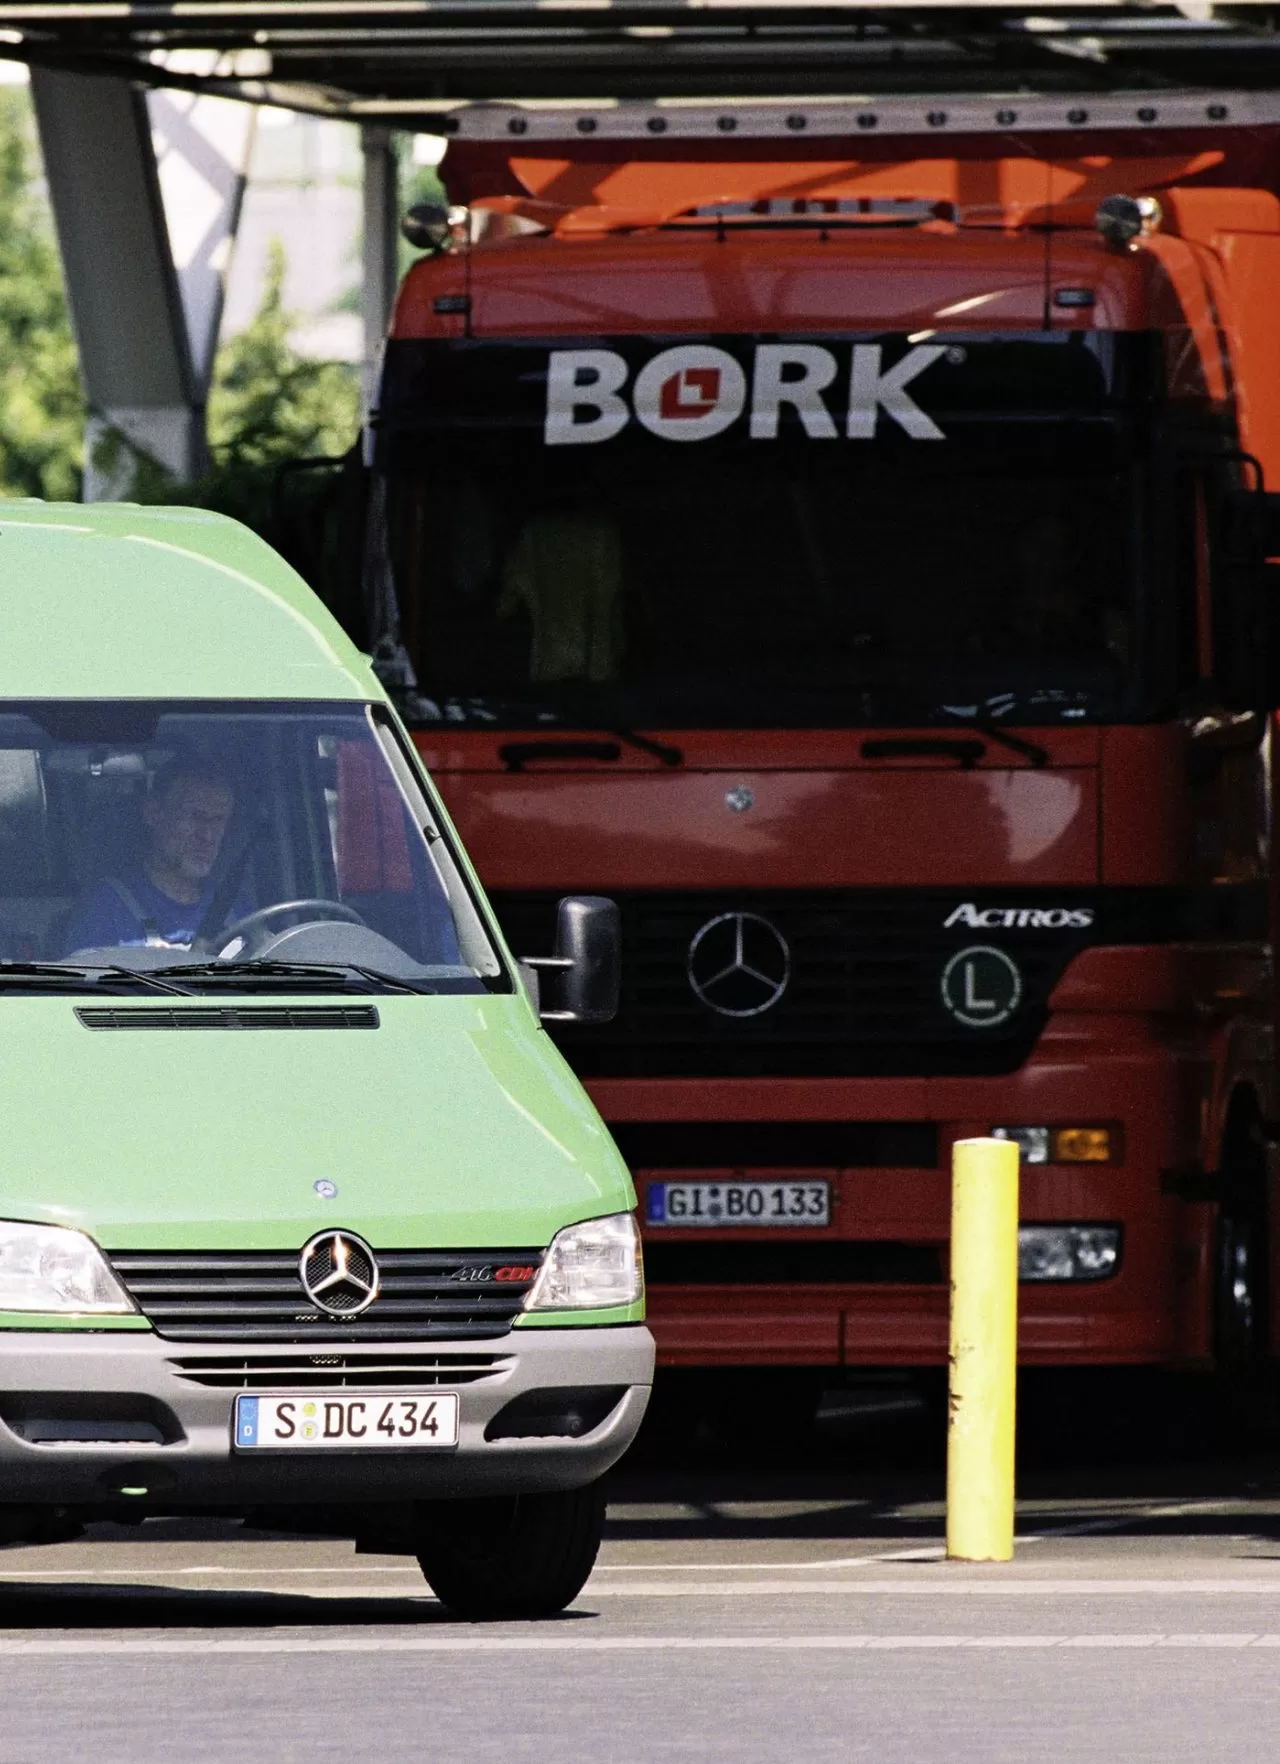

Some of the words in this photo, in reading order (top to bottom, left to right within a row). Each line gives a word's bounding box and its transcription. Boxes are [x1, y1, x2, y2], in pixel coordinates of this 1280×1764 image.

[965, 961, 996, 1009] L
[669, 1188, 704, 1216] GI
[771, 1188, 824, 1216] 133
[495, 1266, 535, 1281] CDI
[274, 1402, 296, 1439] S
[322, 1402, 368, 1438] DC
[376, 1401, 439, 1438] 434
